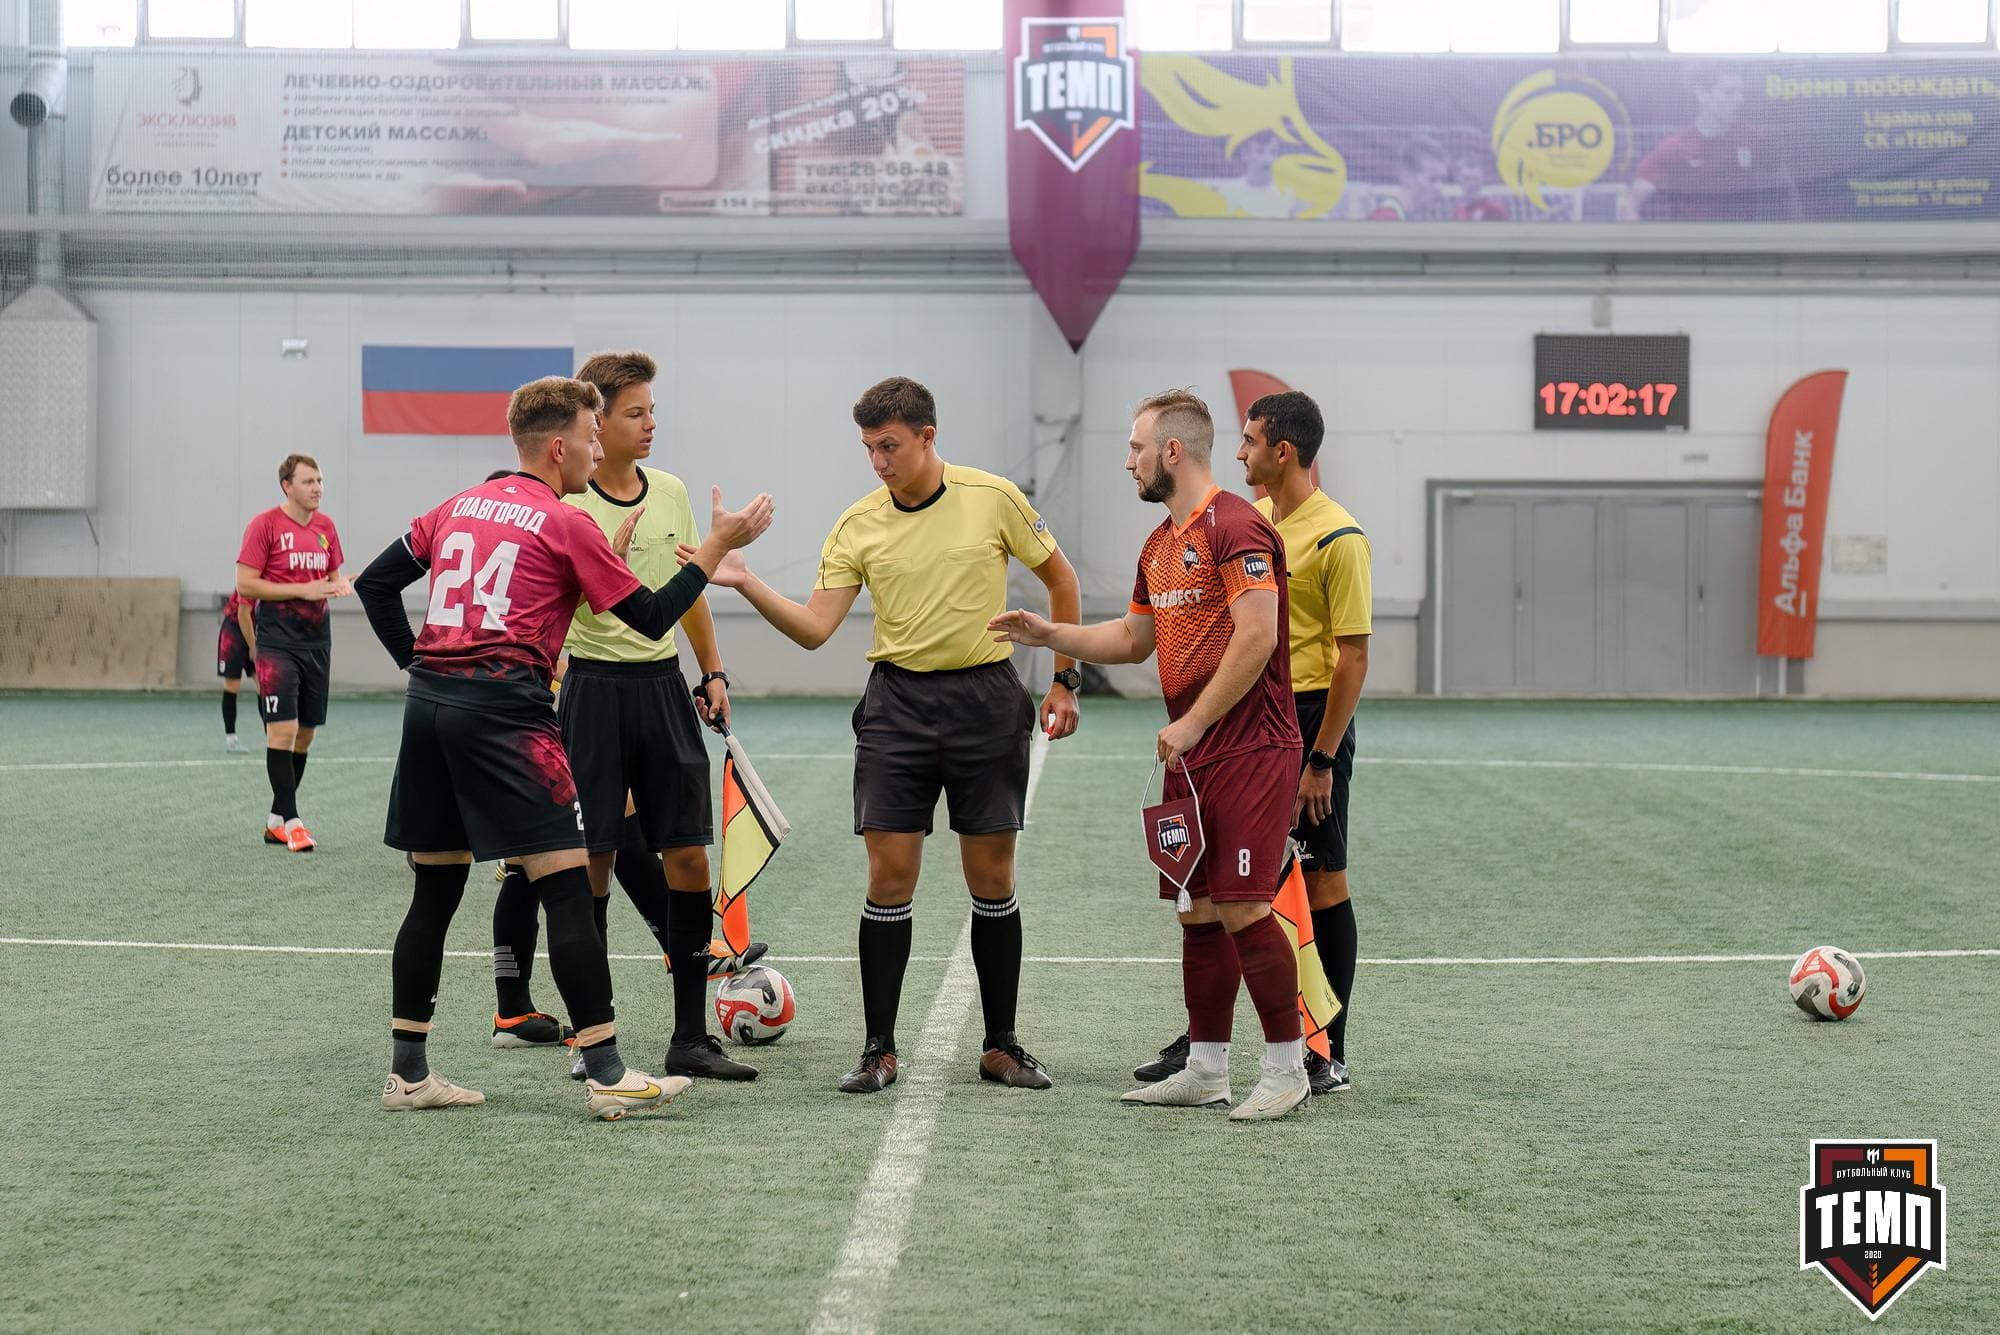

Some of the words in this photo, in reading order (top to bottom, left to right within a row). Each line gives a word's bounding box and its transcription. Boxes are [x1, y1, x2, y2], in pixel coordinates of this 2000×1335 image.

[284, 73, 603, 91] ЛЕЧЕБНО-ОЗДОРОВИТЕЛЬНЫЙ
[1026, 60, 1122, 113] ТЕМП
[1765, 74, 1848, 100] Время
[136, 112, 237, 129] ЭКСКЛЮЗИВ
[283, 122, 381, 144] ДЕТСКИЙ
[388, 125, 488, 142] МАССАЖ:
[107, 164, 183, 186] более
[1540, 382, 1678, 416] 17:02:17
[1785, 431, 1813, 508] Банк
[451, 496, 547, 535] СЛАВГОРОД
[281, 532, 294, 551] 17
[1246, 560, 1269, 573] ТЕМП
[1773, 513, 1807, 615] Альфа
[426, 531, 521, 631] 24
[265, 695, 279, 714] 17
[1160, 828, 1187, 848] ТЕМП
[1238, 848, 1251, 877] 8
